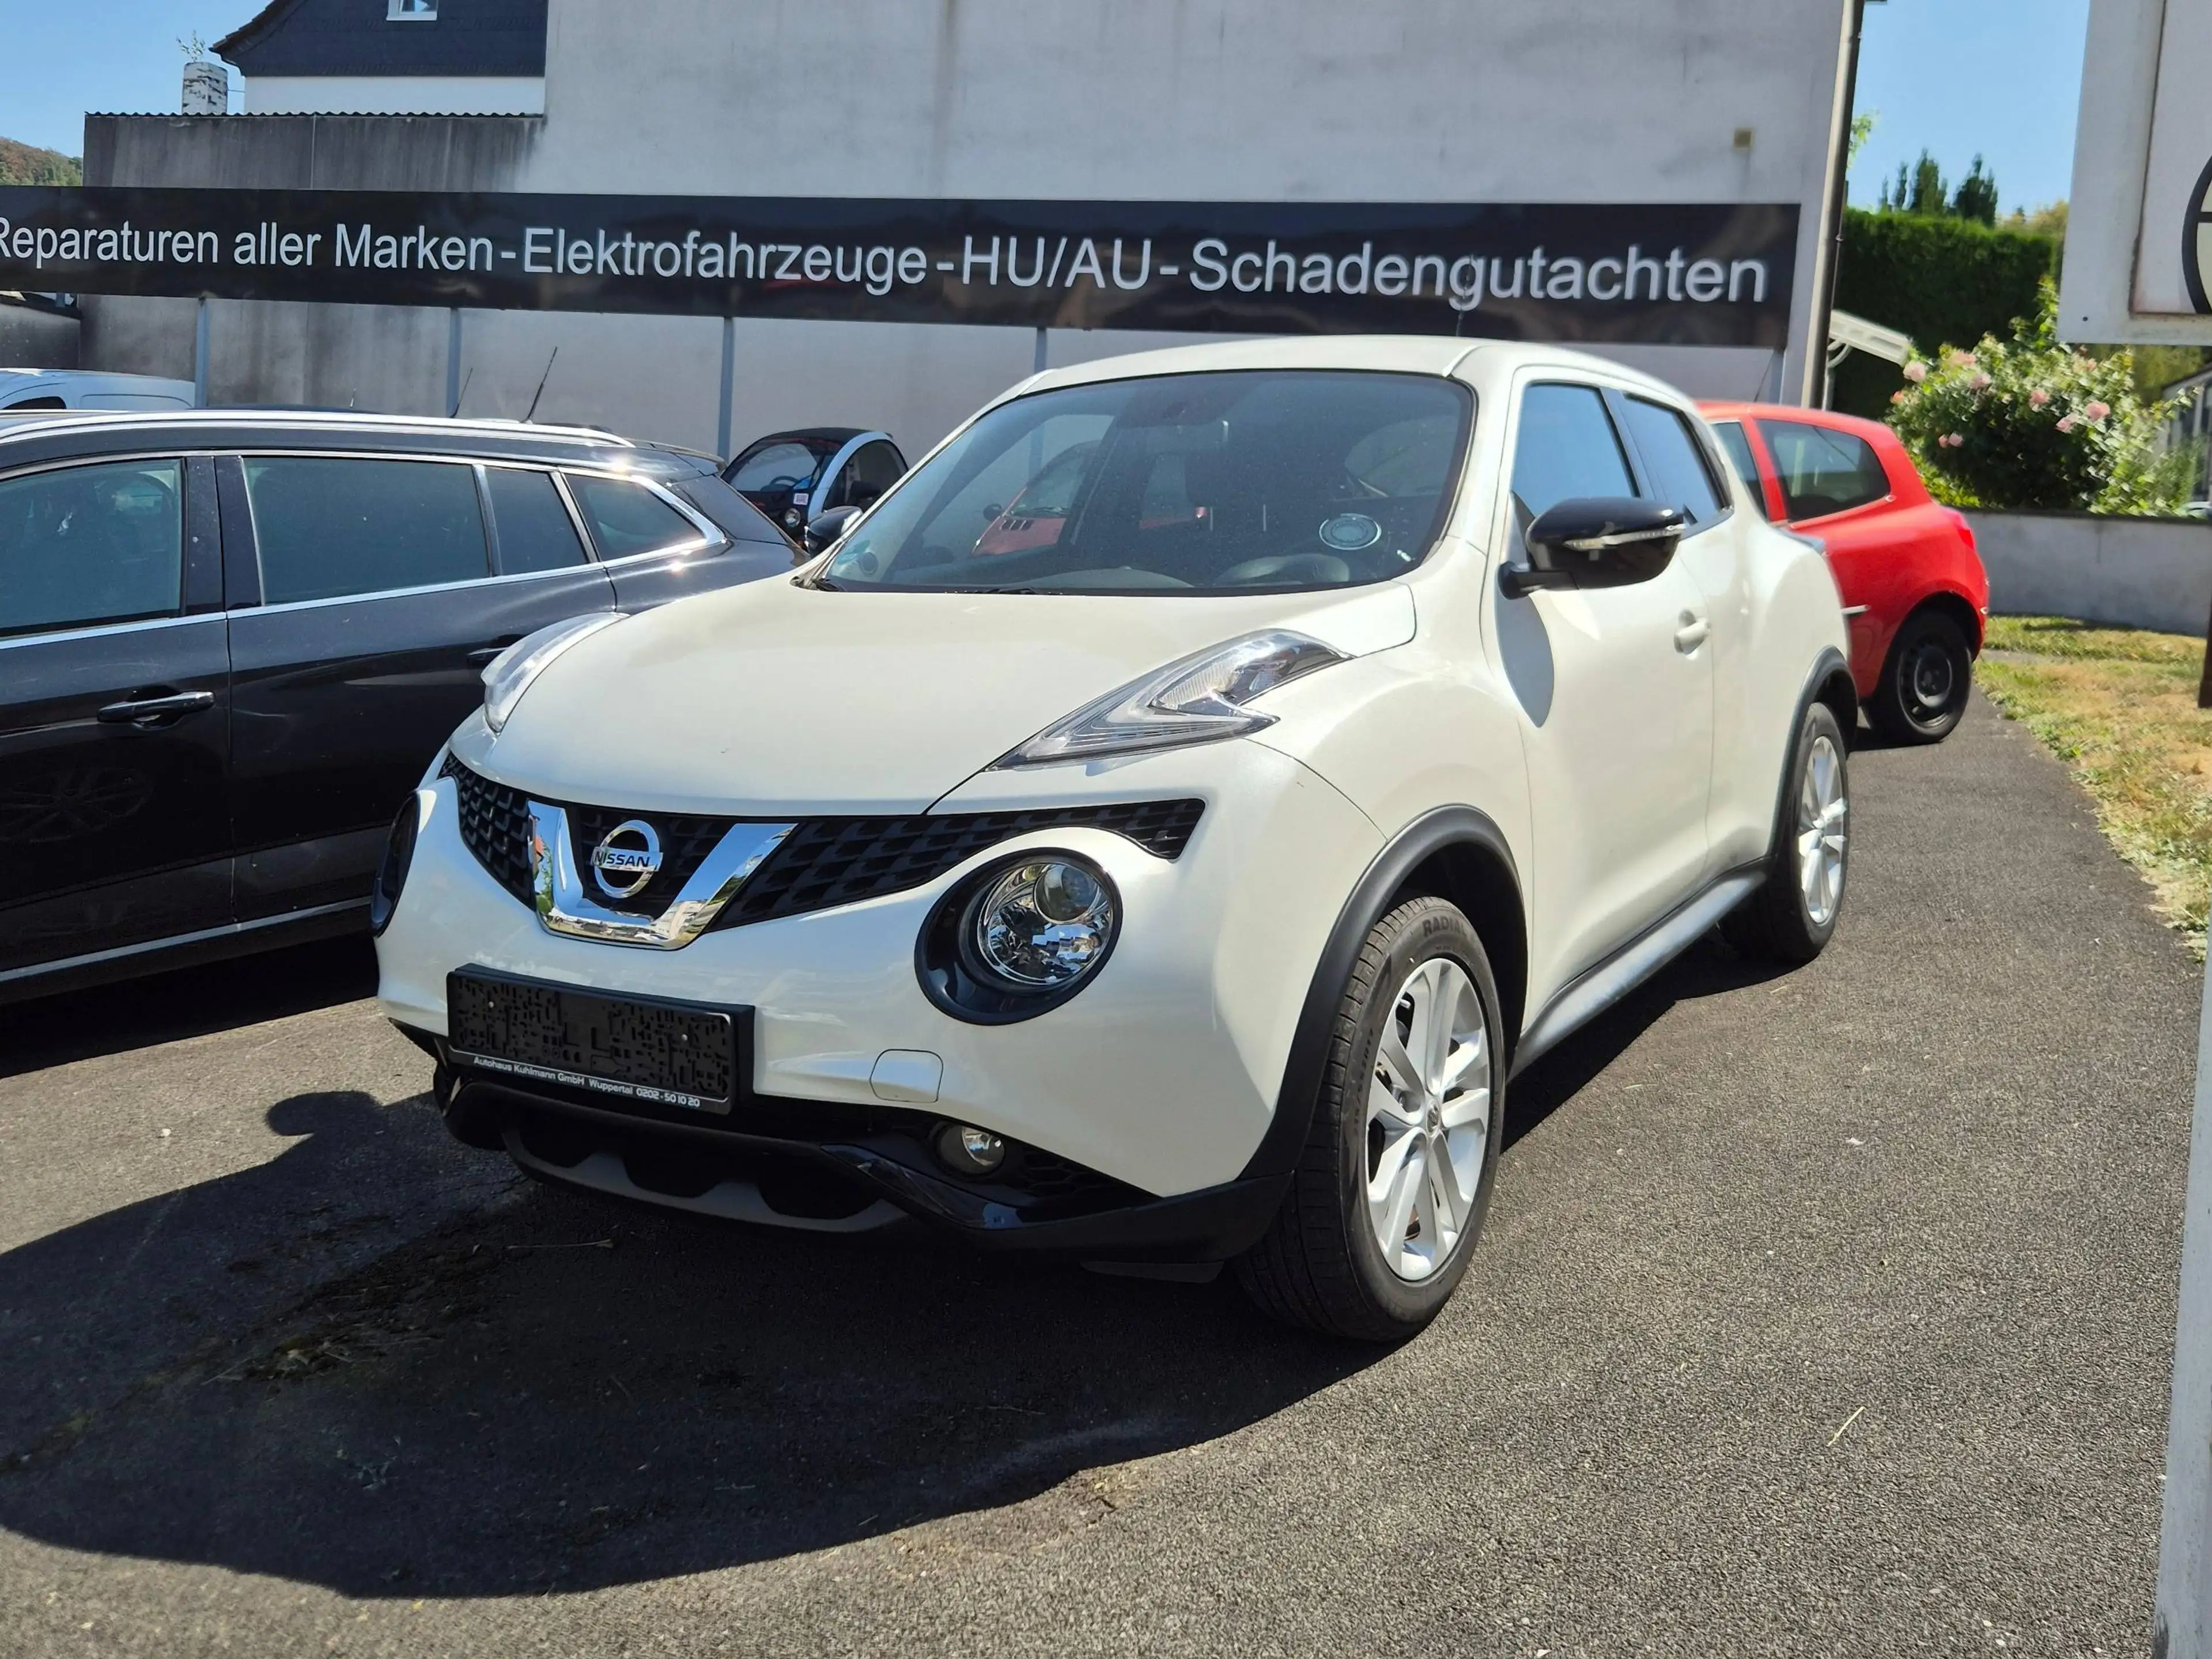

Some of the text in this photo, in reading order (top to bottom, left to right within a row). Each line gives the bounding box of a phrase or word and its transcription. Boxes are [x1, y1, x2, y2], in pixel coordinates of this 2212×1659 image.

[234, 222, 322, 266] aller
[1189, 240, 1767, 311] Schadengutachten
[594, 850, 651, 868] NISSAN
[474, 1056, 512, 1071] Autohaus
[513, 1065, 556, 1080] Kuhlmann
[557, 1073, 585, 1086] GmbH
[588, 1078, 633, 1094] Wuppertal
